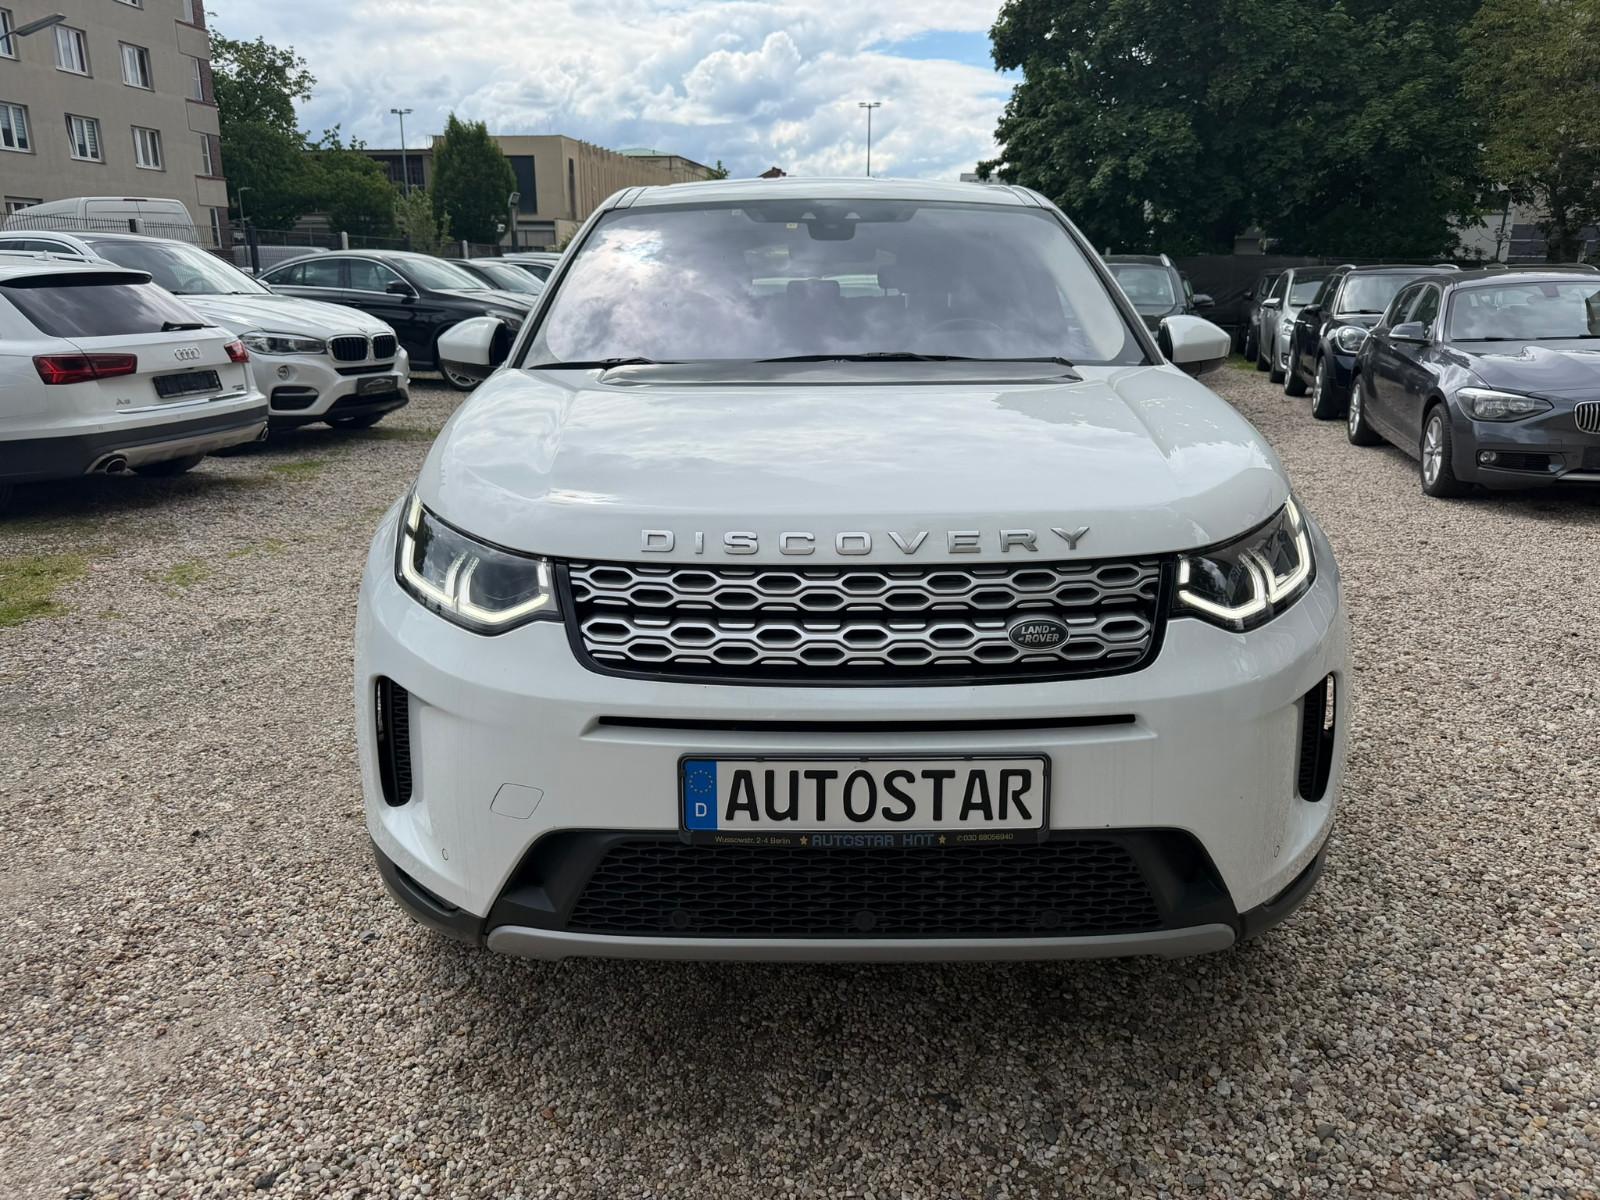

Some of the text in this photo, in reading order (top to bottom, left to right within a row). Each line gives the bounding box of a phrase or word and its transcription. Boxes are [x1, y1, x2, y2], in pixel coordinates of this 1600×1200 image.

[640, 525, 1090, 556] DISCOVERY
[725, 768, 1033, 823] AUTOSTAR
[695, 802, 707, 817] D
[770, 836, 791, 846] Berlin
[812, 834, 894, 847] AUTOSTAR
